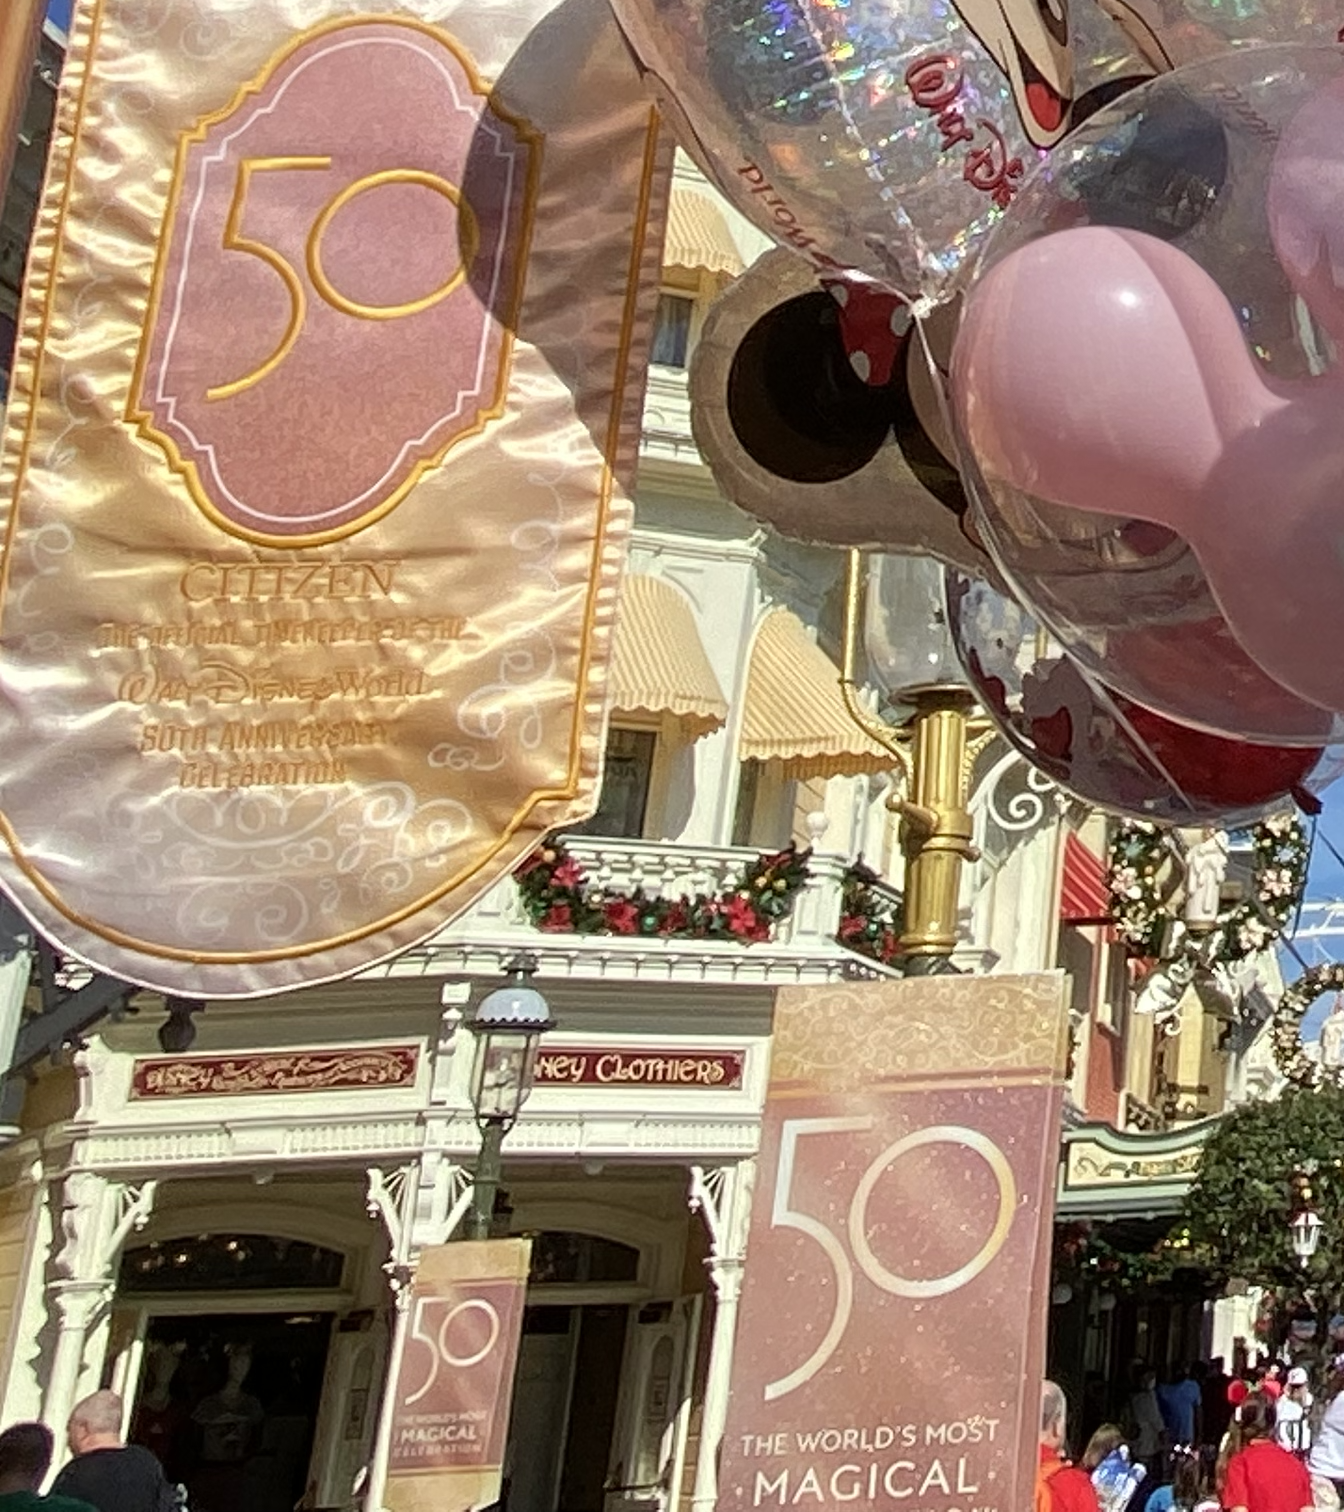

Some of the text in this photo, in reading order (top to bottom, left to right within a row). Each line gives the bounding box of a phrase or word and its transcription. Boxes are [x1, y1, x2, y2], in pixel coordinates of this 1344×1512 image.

[206, 156, 481, 400] 50
[178, 559, 399, 602] CITIZEN
[763, 1112, 1018, 1402] 50
[404, 1296, 500, 1406] 50
[401, 1424, 477, 1443] MAGICAL
[740, 1418, 1001, 1457] THE WORLD'S MOST
[753, 1457, 980, 1507] MAGICAL
